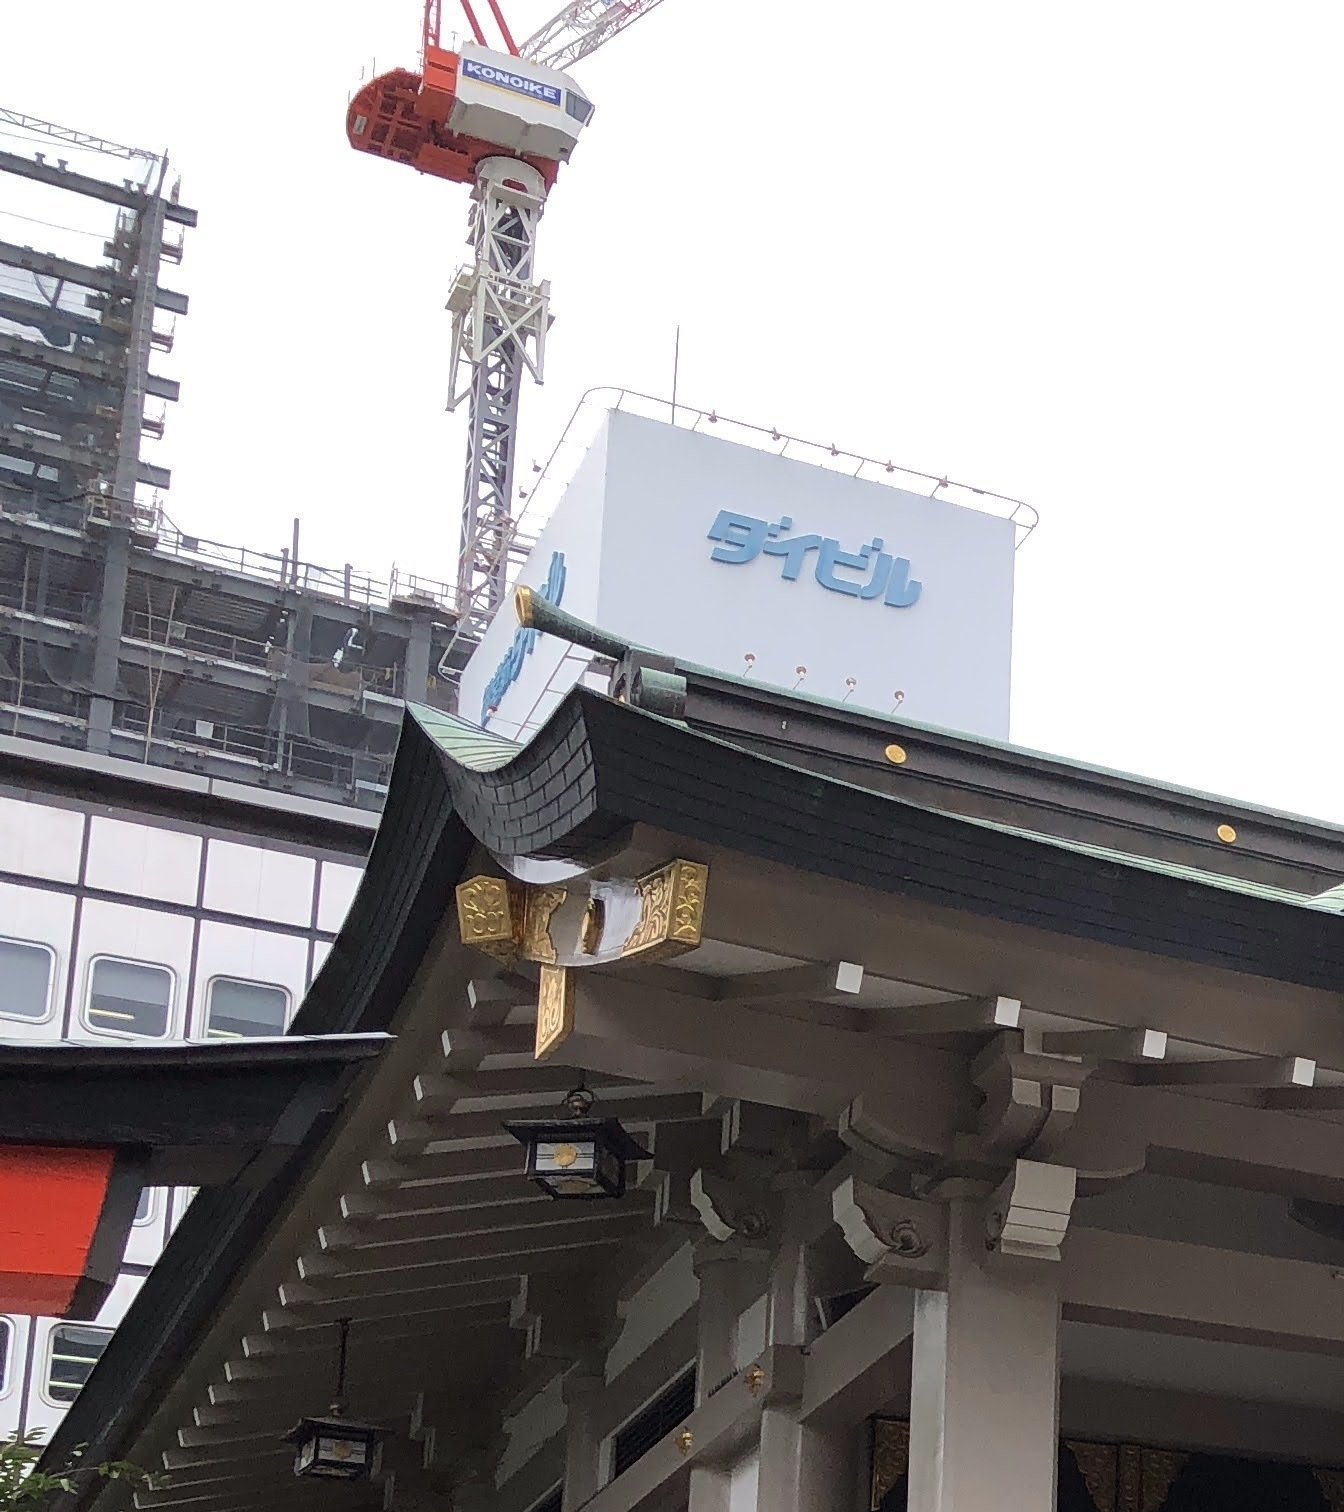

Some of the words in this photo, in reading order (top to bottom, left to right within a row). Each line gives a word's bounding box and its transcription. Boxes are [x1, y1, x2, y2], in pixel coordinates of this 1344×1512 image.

[467, 62, 556, 99] KONOIKE
[707, 509, 922, 608] ダイビル
